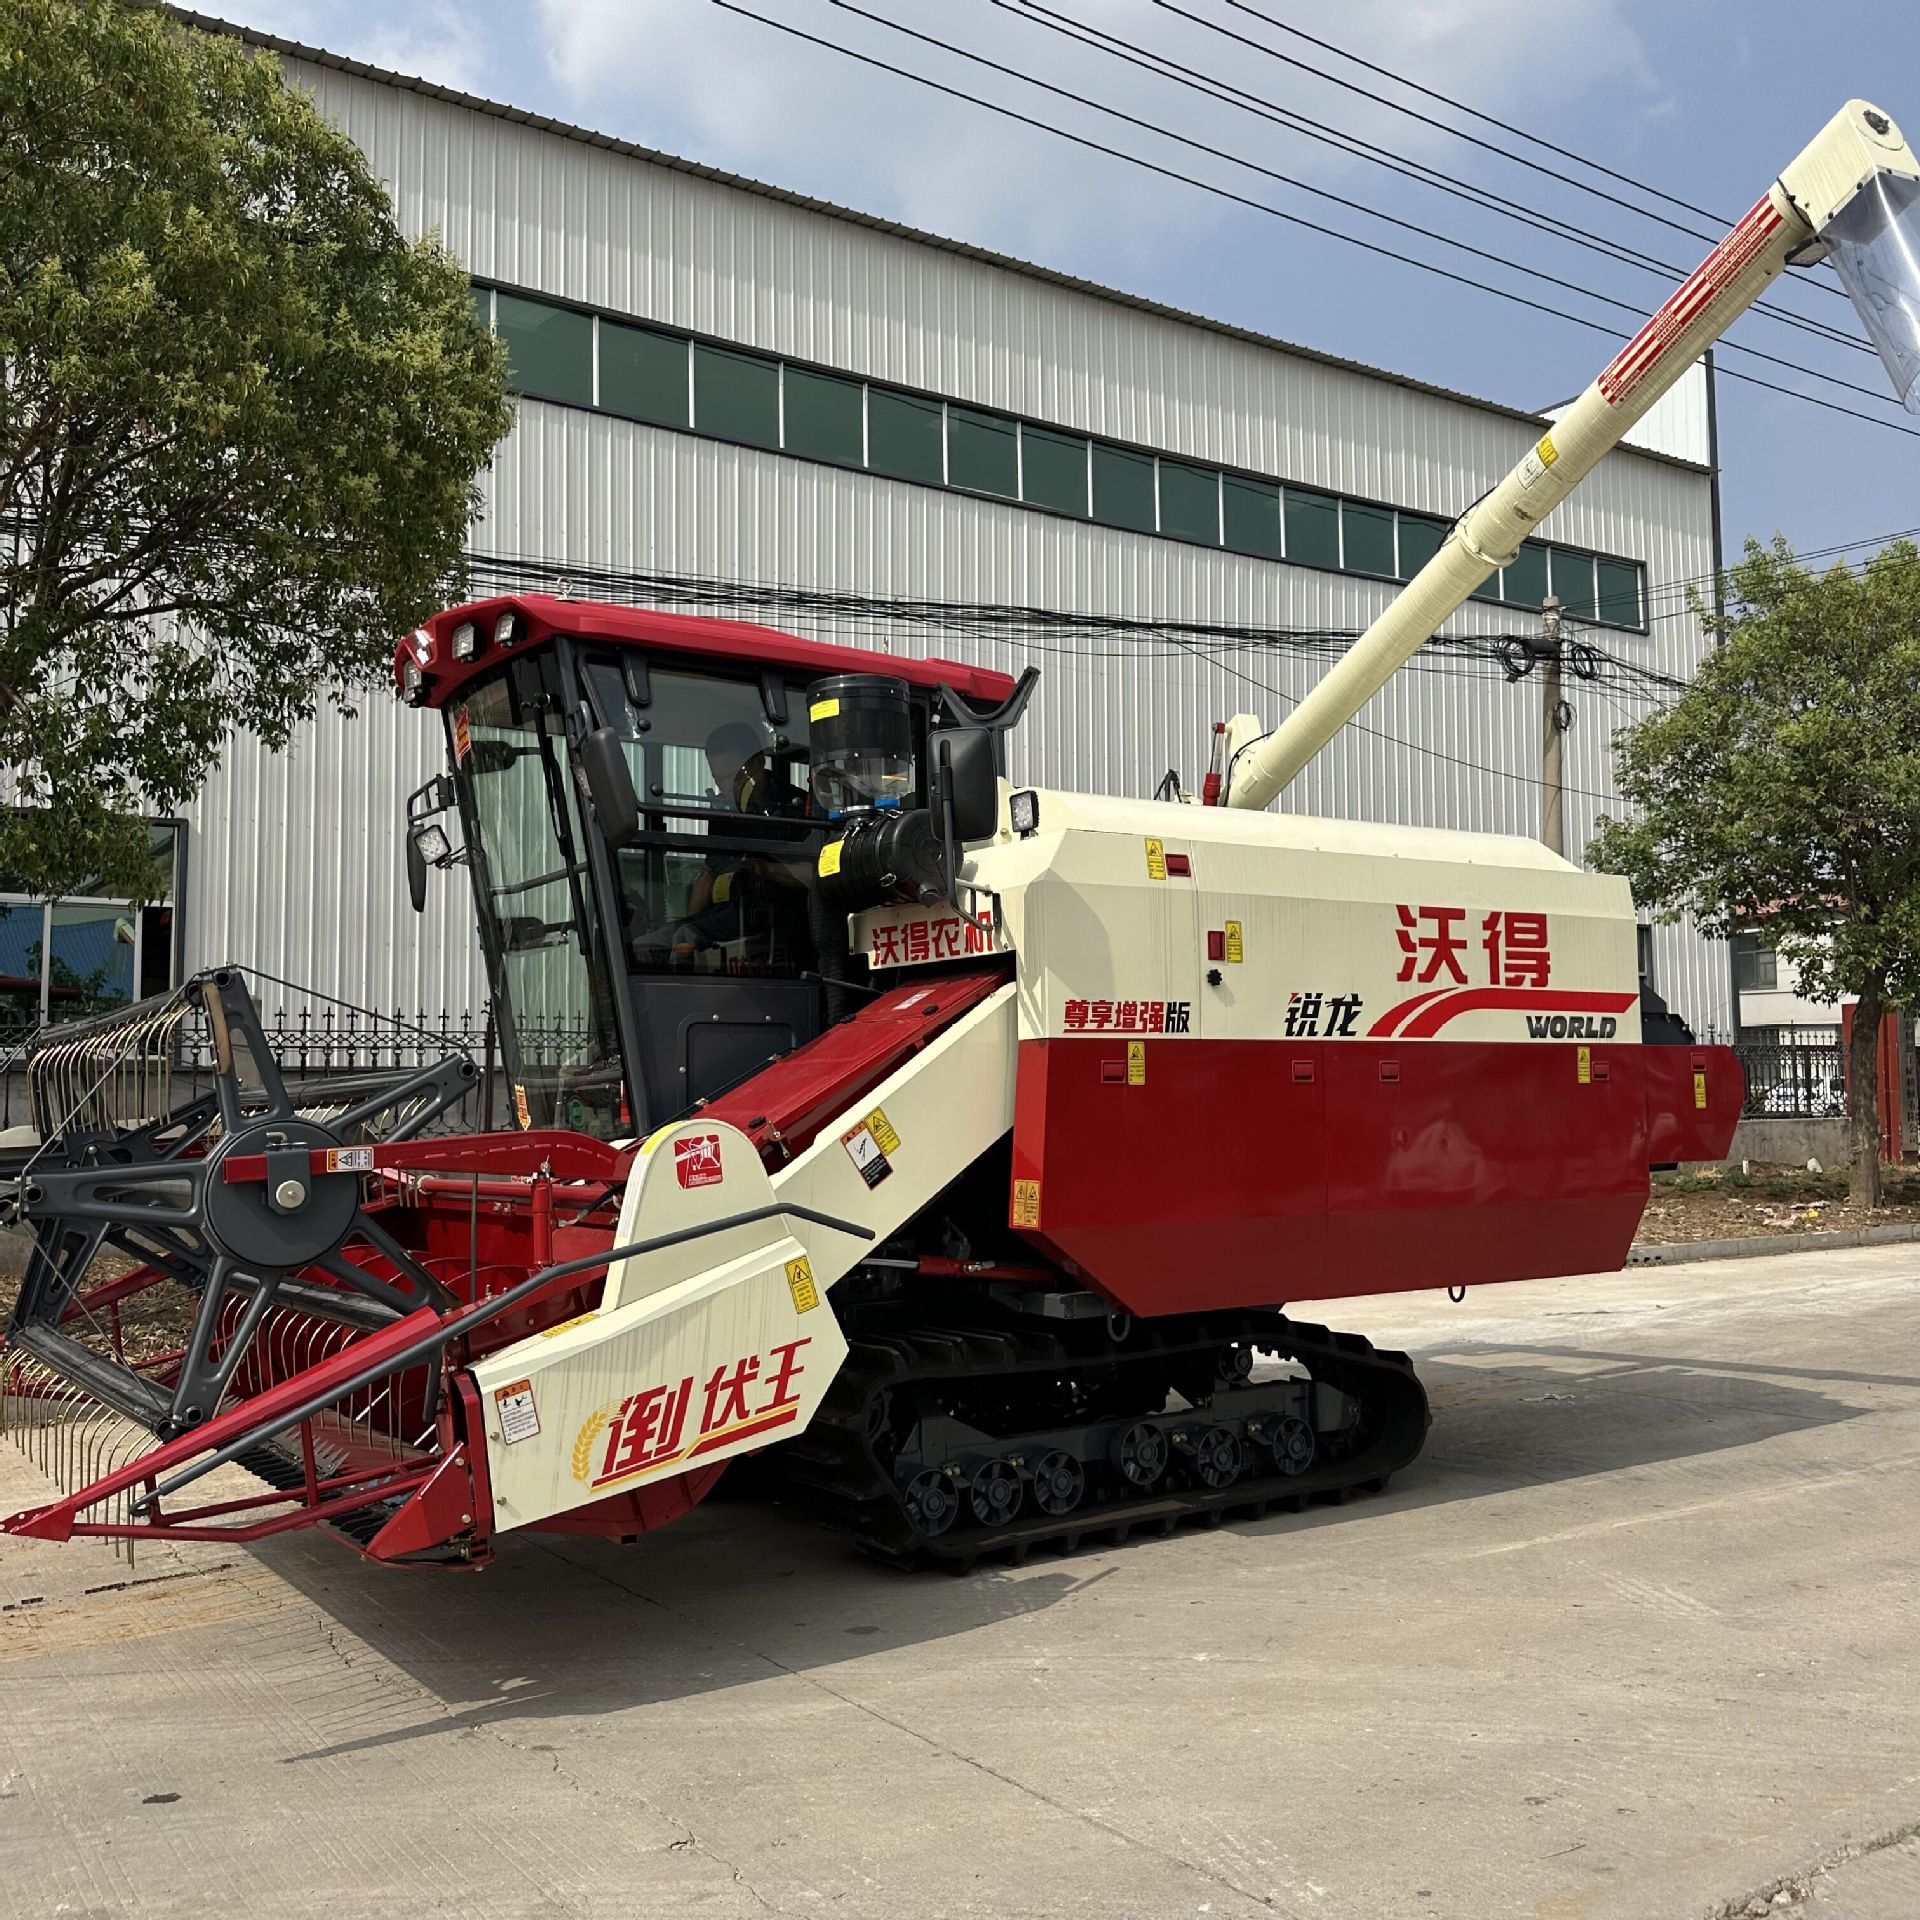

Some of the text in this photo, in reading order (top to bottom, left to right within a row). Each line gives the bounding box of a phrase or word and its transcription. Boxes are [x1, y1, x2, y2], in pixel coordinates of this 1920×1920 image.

[1395, 904, 1551, 988] 沃得
[1064, 999, 1191, 1033] 尊享增强版
[1284, 992, 1364, 1037] 锐龙
[1525, 1015, 1617, 1039] WORLD
[602, 1336, 813, 1477] 倒伏王
